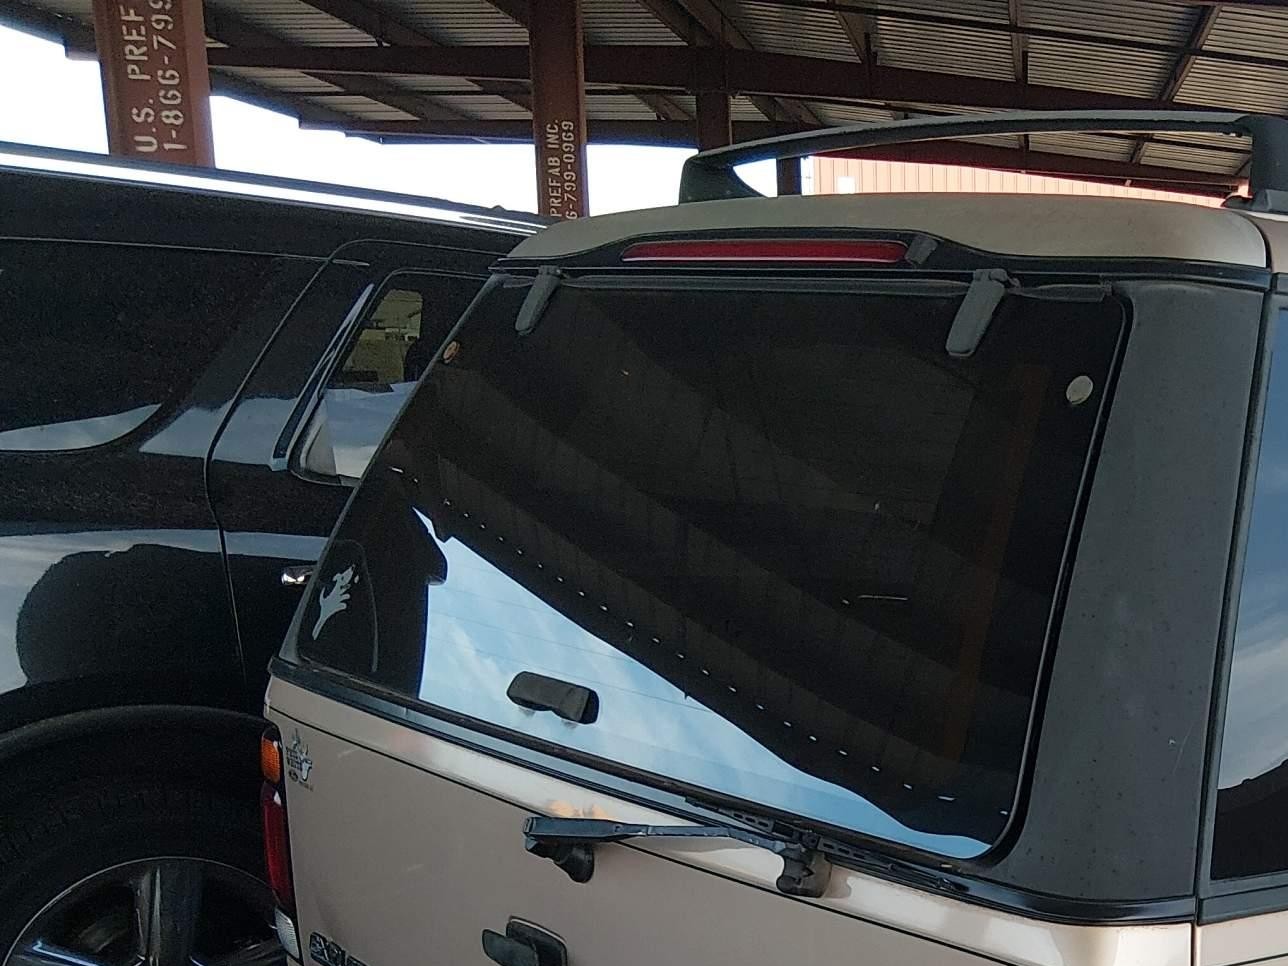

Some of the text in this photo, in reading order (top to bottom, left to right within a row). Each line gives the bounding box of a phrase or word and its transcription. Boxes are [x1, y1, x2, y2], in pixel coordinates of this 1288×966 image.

[120, 4, 158, 152] U.S. PREF
[546, 119, 563, 217] PREFAB INC.
[561, 121, 578, 220] 6-799-0969
